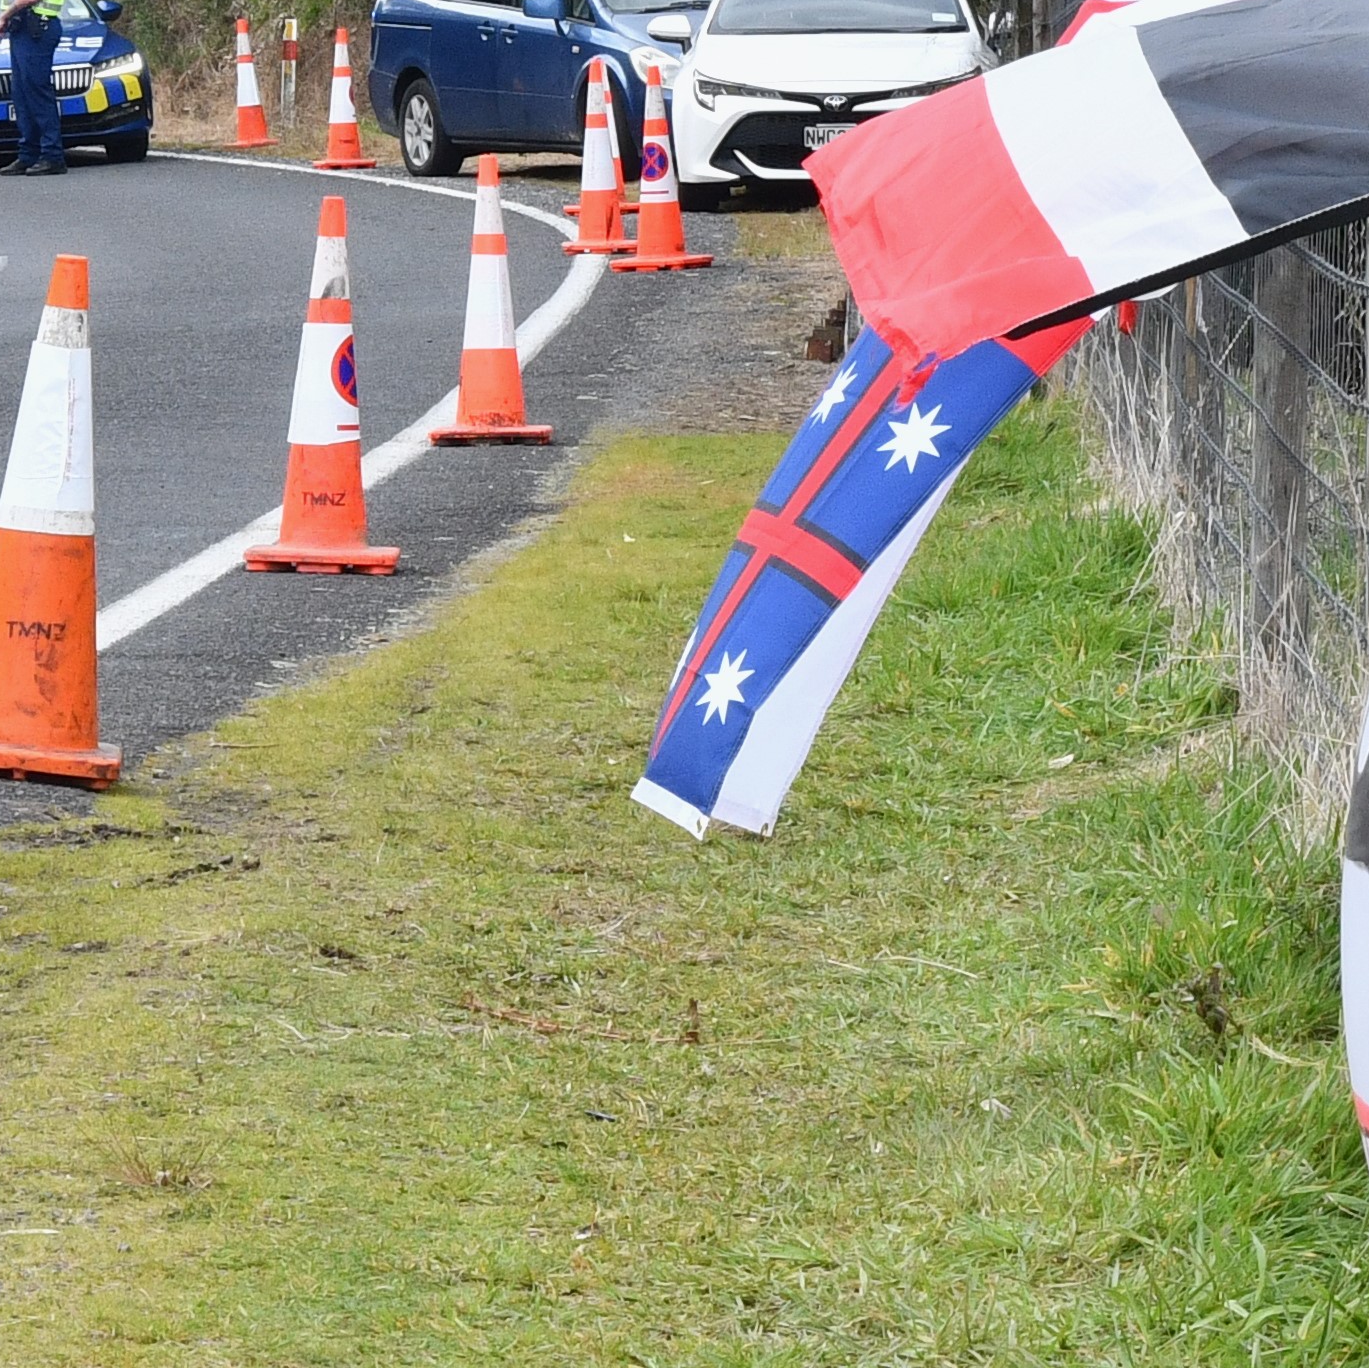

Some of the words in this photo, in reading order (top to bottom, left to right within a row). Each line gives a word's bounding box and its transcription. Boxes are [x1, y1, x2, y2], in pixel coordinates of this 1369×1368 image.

[806, 130, 846, 145] NWC
[301, 489, 347, 507] TMNZ
[5, 620, 66, 642] TMNZ
